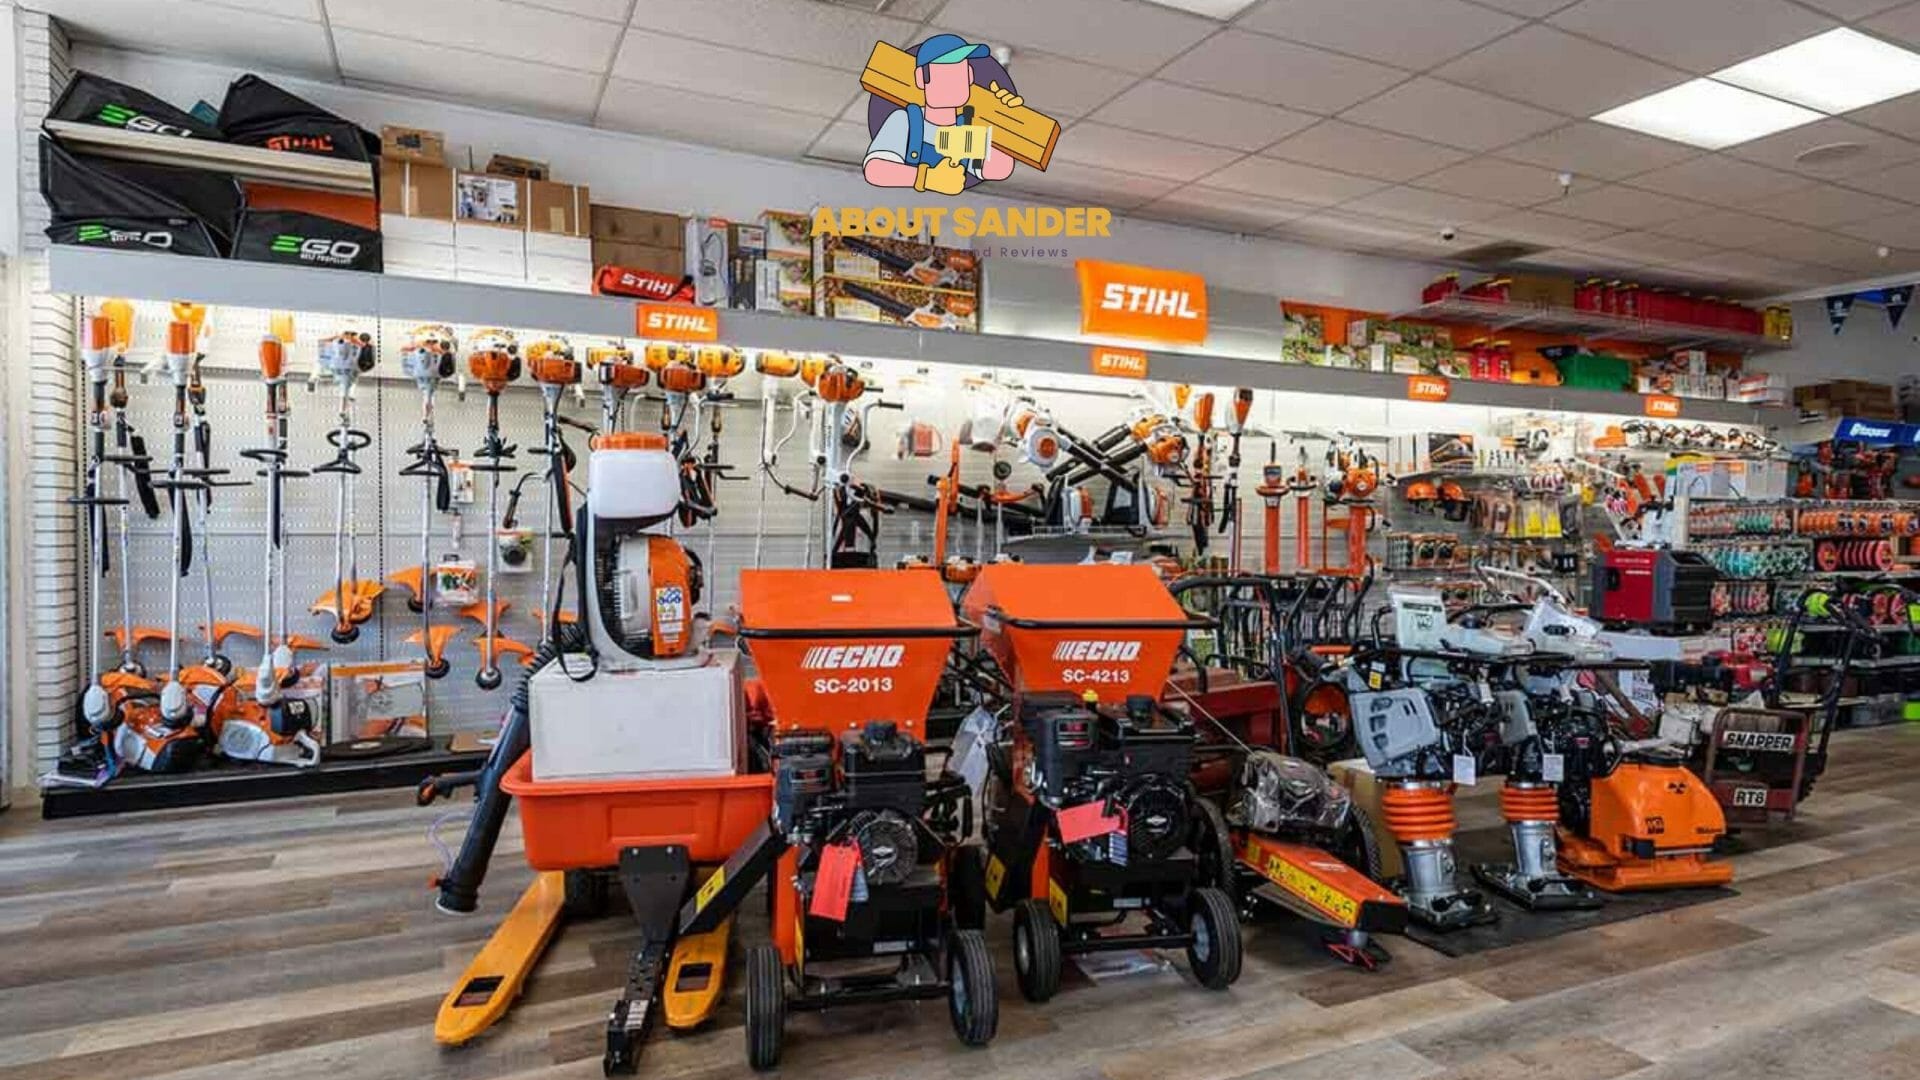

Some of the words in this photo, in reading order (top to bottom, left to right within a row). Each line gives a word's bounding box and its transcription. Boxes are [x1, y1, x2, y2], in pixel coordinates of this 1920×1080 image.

[267, 135, 333, 151] STIHL
[271, 235, 361, 259] EGO
[1101, 282, 1198, 319] STIHL
[647, 312, 711, 333] STIHL
[1101, 353, 1143, 370] STIHL
[1416, 381, 1447, 396] STIHL
[822, 644, 905, 668] ECHO
[1064, 640, 1142, 661] ECHO
[1062, 668, 1130, 683] SC-4213
[813, 676, 893, 694] SC-2013
[1727, 732, 1791, 749] SNAPPER
